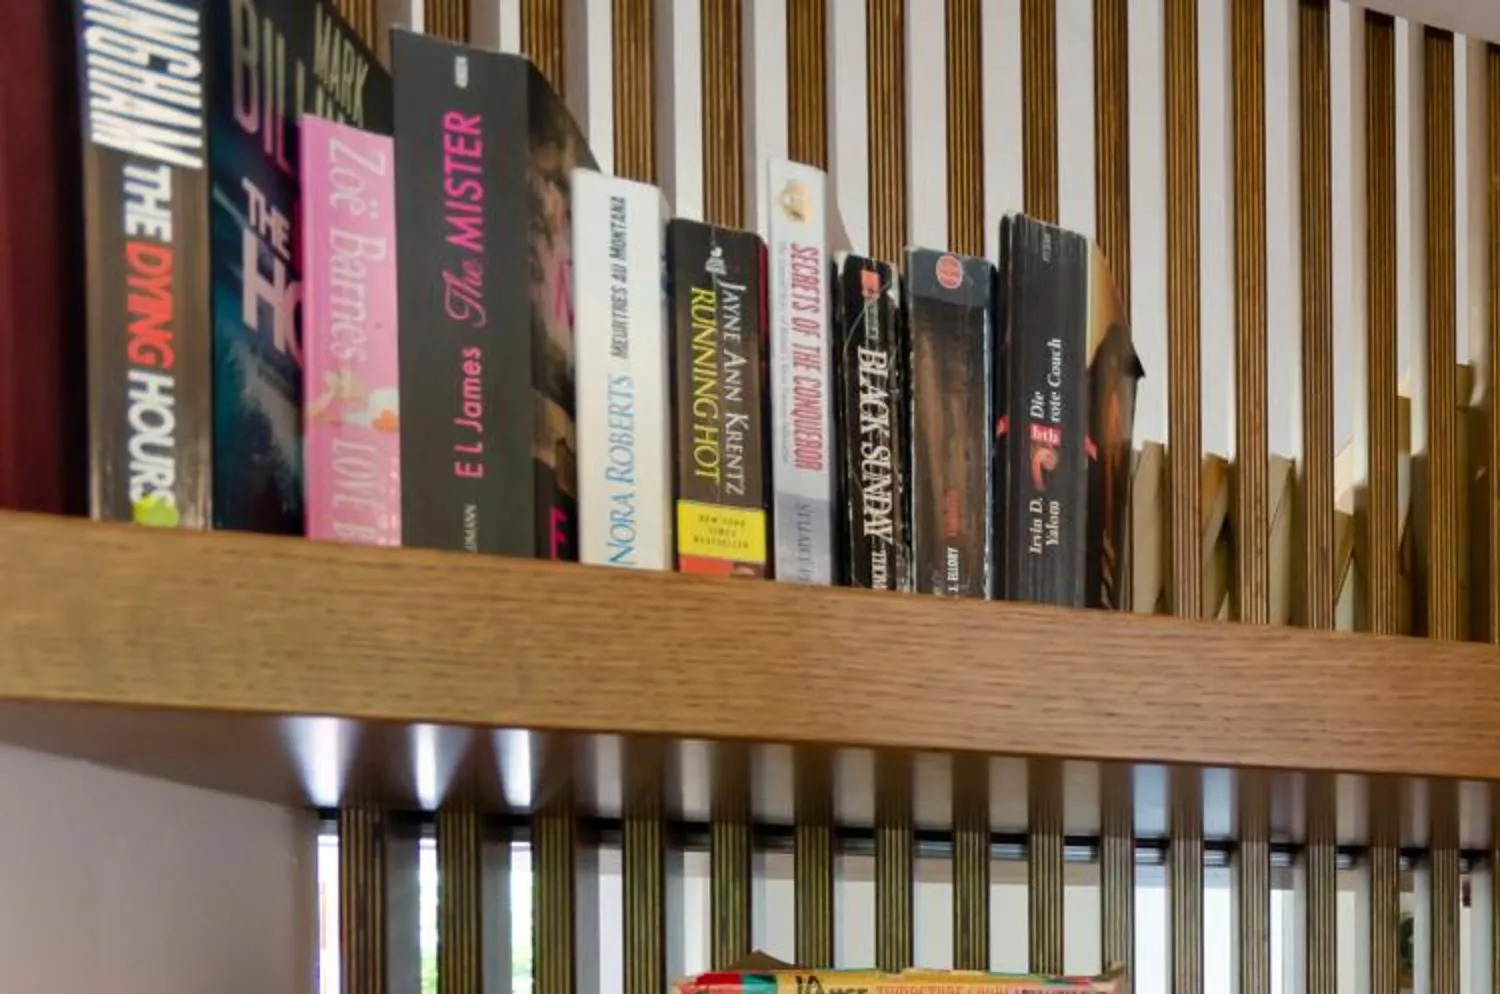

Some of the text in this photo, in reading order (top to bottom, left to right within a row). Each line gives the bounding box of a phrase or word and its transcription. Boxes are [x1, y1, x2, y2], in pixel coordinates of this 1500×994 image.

[442, 110, 486, 328] The MISTER
[609, 196, 627, 262] MONTANA
[122, 164, 177, 507] THE DYING HOURS
[328, 229, 387, 366] Barnes
[790, 243, 823, 472] SECRETS OF THE CONQUEROR
[455, 346, 482, 479] E L James
[691, 286, 720, 485] RUNNING HOT
[719, 280, 751, 496] JAYNE ANN KRENTZ
[858, 346, 890, 438] BLACK
[1030, 391, 1045, 419] Die
[1047, 338, 1062, 423] rote Couch
[606, 373, 639, 566] NORA ROBERTS
[860, 441, 894, 545] SUNDAY
[1046, 501, 1060, 546] Yalom
